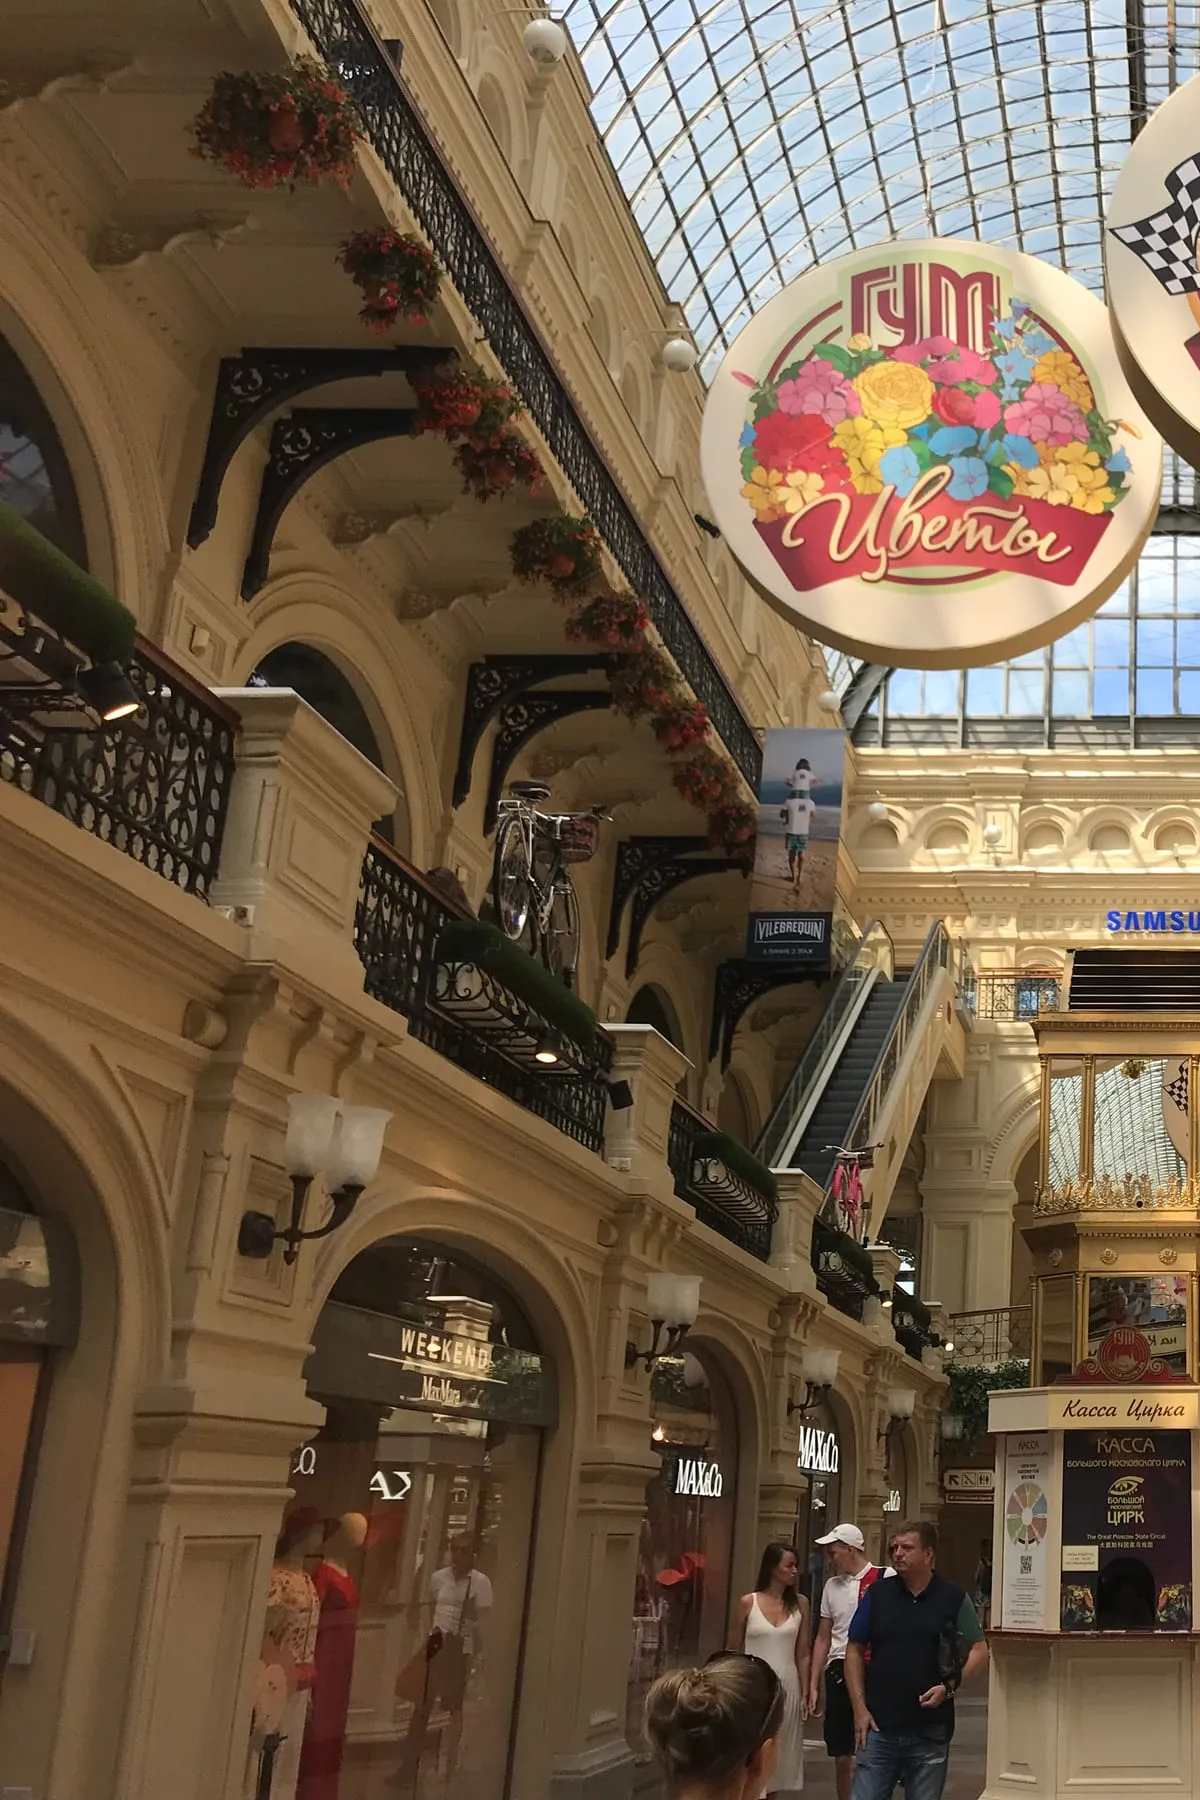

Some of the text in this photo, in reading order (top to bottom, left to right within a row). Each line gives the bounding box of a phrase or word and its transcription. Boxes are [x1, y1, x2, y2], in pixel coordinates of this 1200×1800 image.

[851, 263, 1001, 357] ГУМ
[781, 465, 1072, 580] Цветы
[758, 921, 822, 940] VILEBREQUIN
[401, 1327, 489, 1369] WEEKEND
[1062, 1398, 1186, 1422] Касса Цирка
[1097, 1438, 1156, 1453] КАССА
[1107, 1495, 1145, 1504] БОЛЬШОЙ
[1107, 1510, 1145, 1527] ЦИРК
